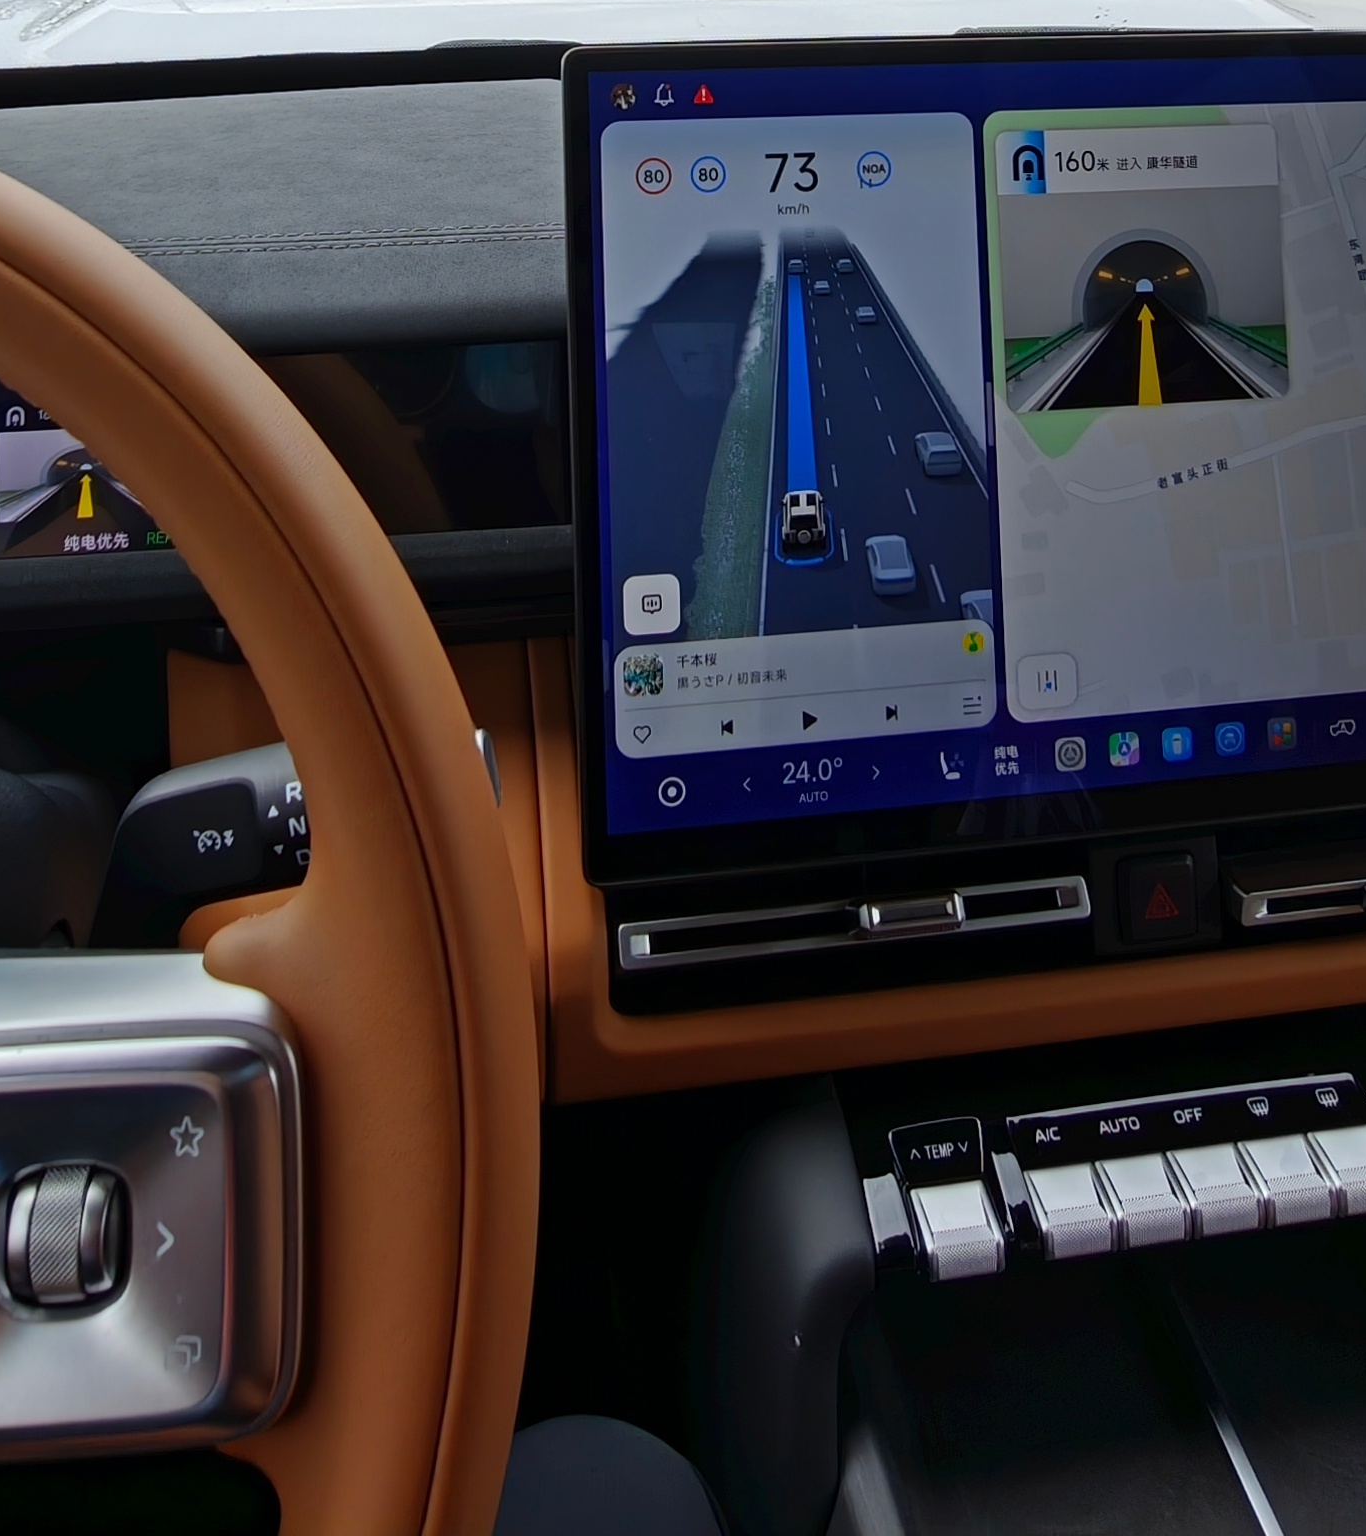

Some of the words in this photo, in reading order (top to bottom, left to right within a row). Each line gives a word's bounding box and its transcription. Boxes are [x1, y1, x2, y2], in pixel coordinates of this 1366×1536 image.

[764, 151, 820, 194] 73
[861, 163, 887, 175] NOA
[1116, 157, 1143, 171] 进入
[643, 169, 665, 184] 80
[697, 167, 719, 182] 80
[777, 202, 810, 216] km/h
[63, 530, 130, 553] 纯电优先
[994, 744, 1020, 760] 纯电
[782, 757, 844, 785] 24.0°
[995, 760, 1020, 776] 优先
[285, 780, 303, 804] R
[798, 791, 829, 803] AUTO
[288, 815, 307, 837] N
[1099, 1115, 1141, 1135] AUTO
[1173, 1106, 1203, 1125] OFF
[1035, 1125, 1061, 1144] A/C
[923, 1141, 955, 1160] TEMP
